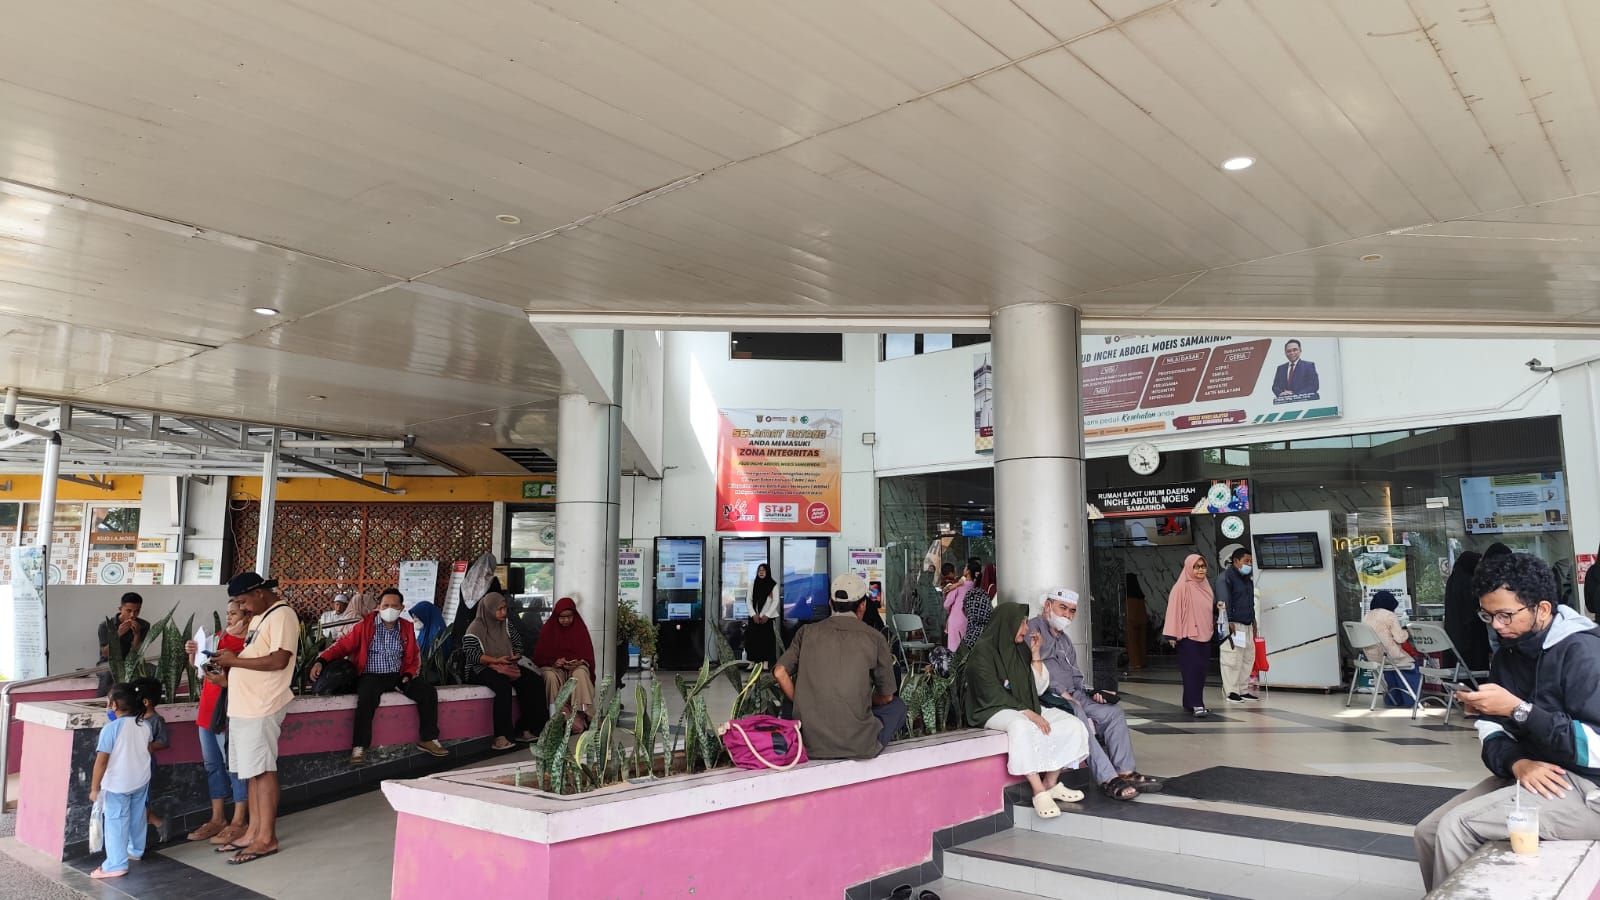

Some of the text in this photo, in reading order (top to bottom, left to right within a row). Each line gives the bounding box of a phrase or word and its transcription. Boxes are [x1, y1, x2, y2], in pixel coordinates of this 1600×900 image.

[1094, 349, 1118, 361] INCHE
[1119, 344, 1150, 357] ABDOEL
[1152, 339, 1177, 352] MOEIS
[1121, 411, 1156, 422] Kesehatan
[732, 428, 827, 439] SELAMAT DATANG
[740, 449, 820, 457] ZONA INTEGRITAS
[1144, 489, 1165, 497] UMUM
[1166, 487, 1196, 495] DAERAH
[1104, 494, 1190, 507] INCHE ABDUL MOEIS
[765, 504, 792, 513] STOP
